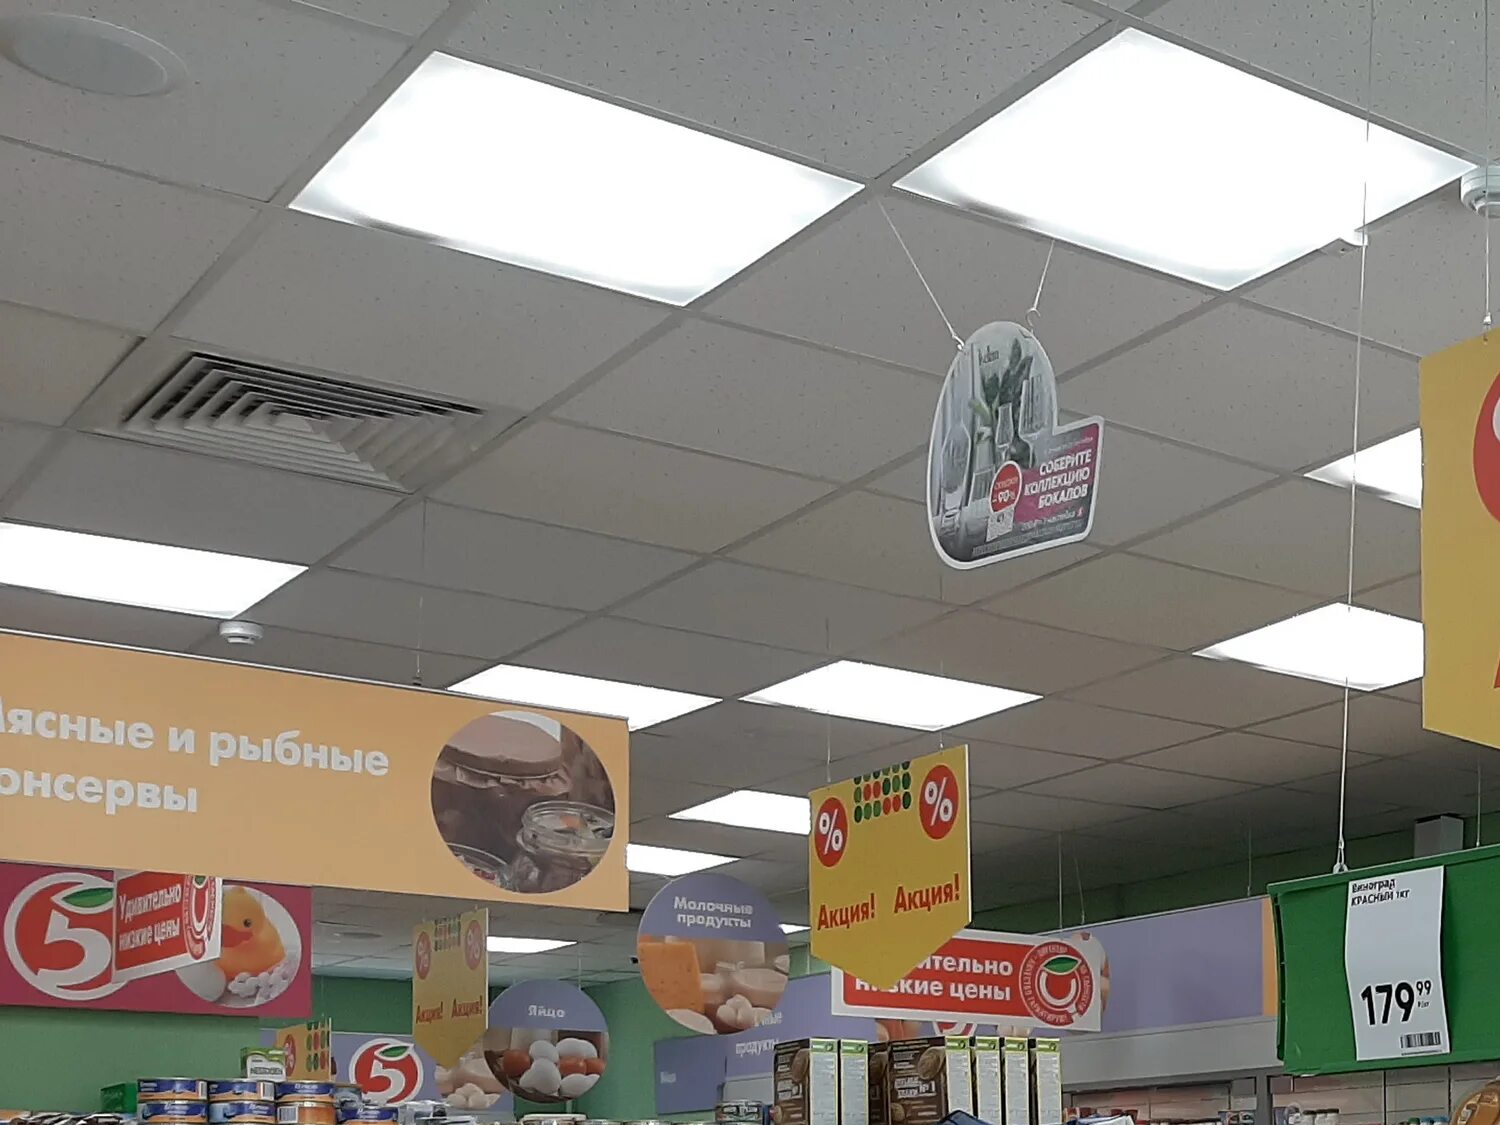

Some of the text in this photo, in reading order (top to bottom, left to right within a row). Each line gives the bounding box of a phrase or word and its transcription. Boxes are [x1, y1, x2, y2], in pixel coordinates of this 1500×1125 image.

[1039, 451, 1091, 476] СОБЕРИТЕ
[1024, 470, 1090, 496] КОЛЛЕКЦИЮ
[1038, 484, 1087, 509] БОКАЛОВ
[168, 728, 195, 753] и
[209, 730, 390, 776] рыбные
[0, 768, 198, 814] онсервы
[1352, 879, 1395, 893] Виноград
[120, 884, 181, 921] Удивительно
[674, 897, 753, 914] Молочные
[817, 873, 960, 931] Акция! Акция!
[154, 919, 180, 946] цены
[677, 914, 751, 928] продукты
[949, 982, 1010, 1000] цены
[1361, 980, 1431, 1025] 179 99
